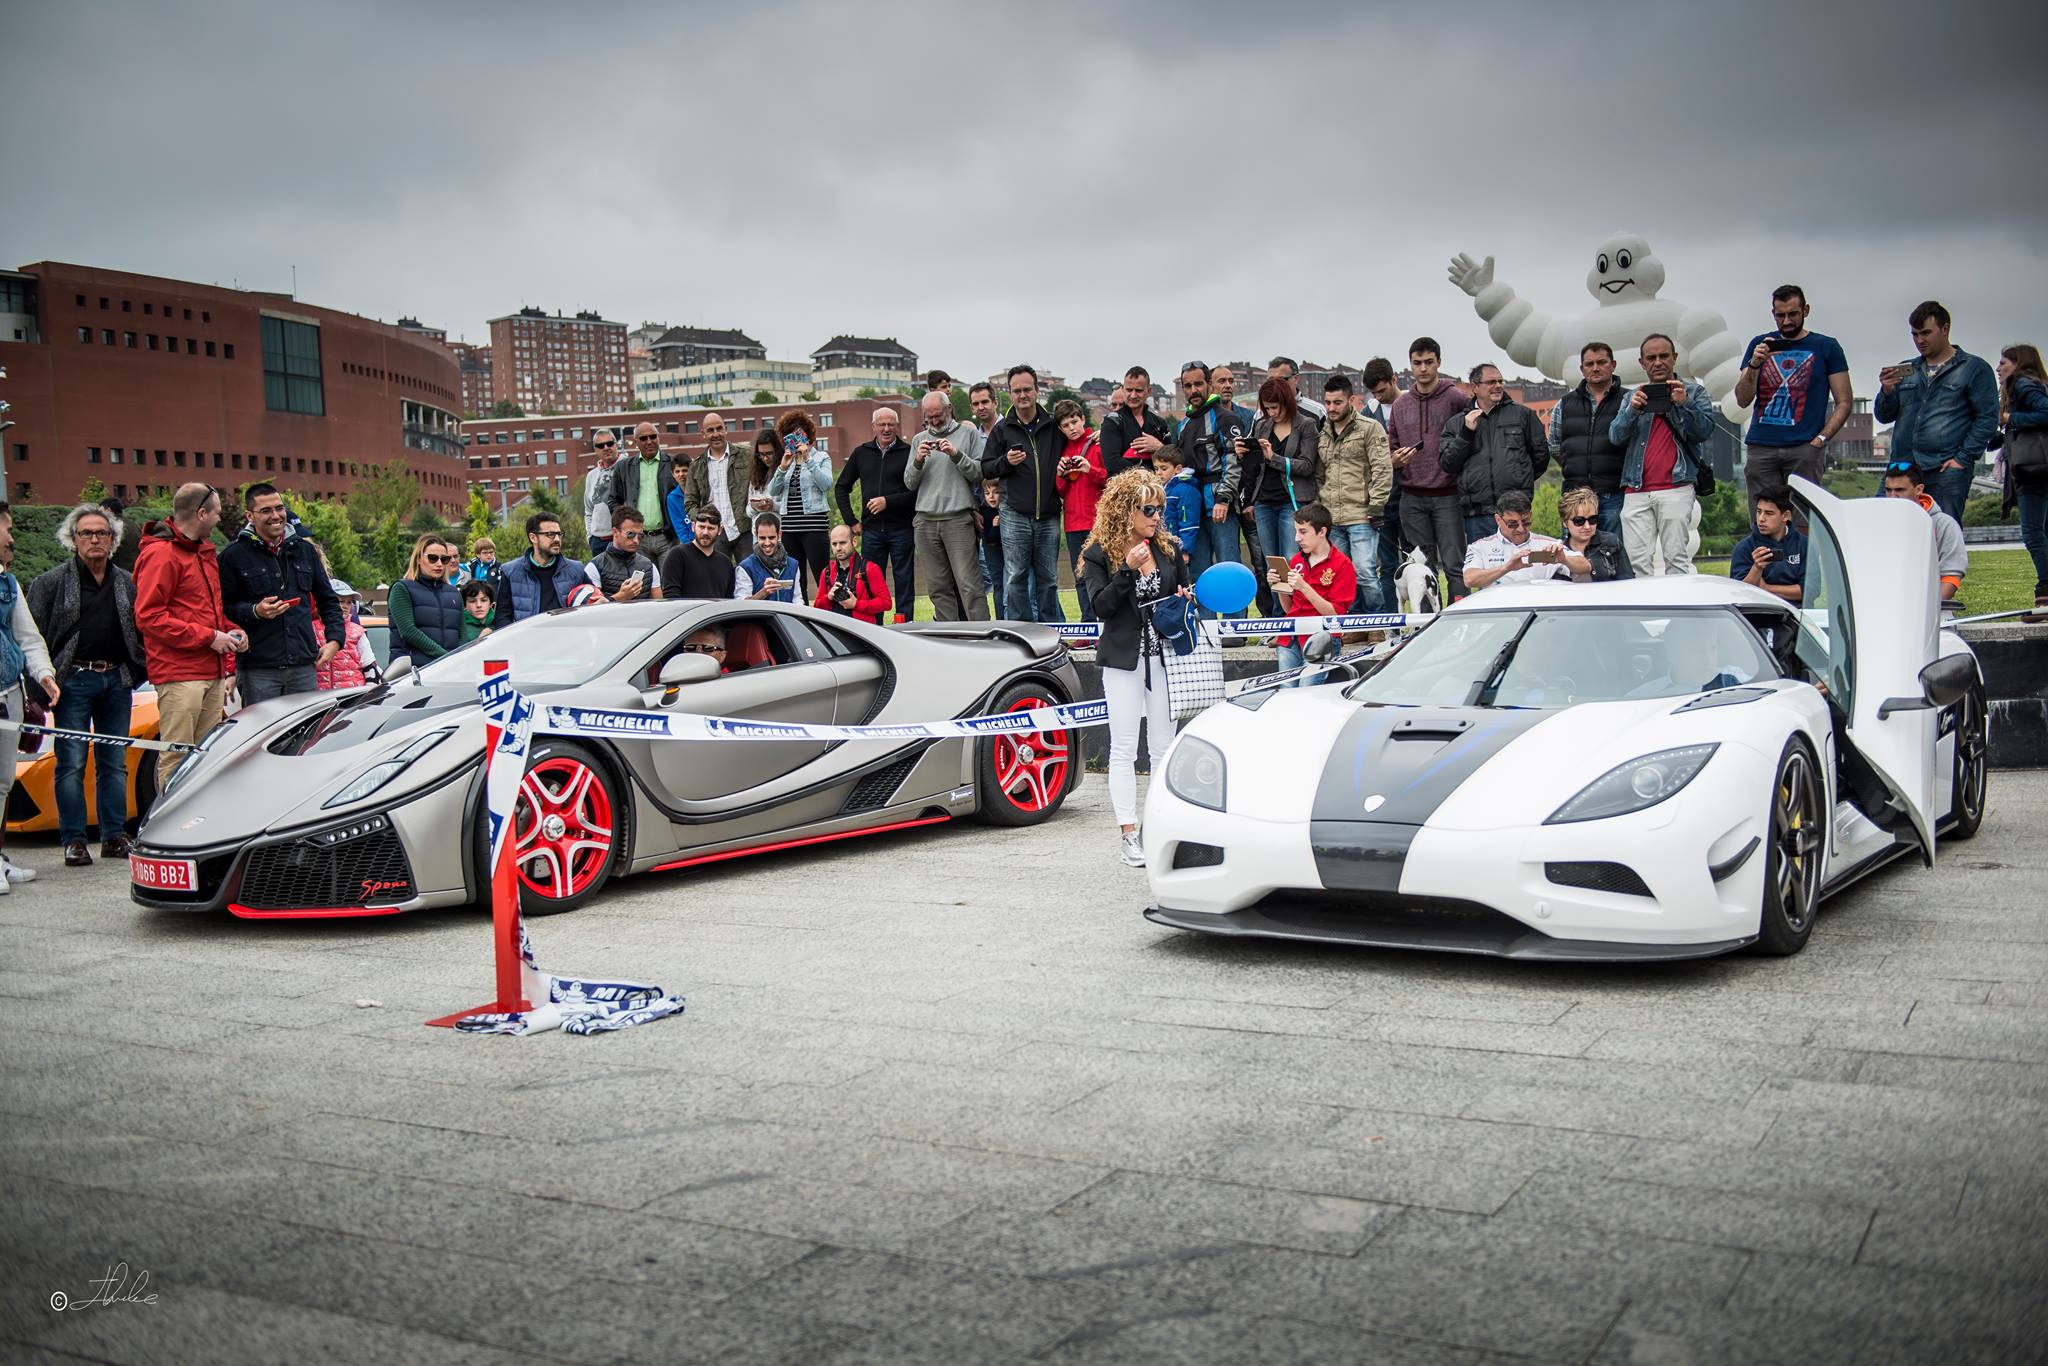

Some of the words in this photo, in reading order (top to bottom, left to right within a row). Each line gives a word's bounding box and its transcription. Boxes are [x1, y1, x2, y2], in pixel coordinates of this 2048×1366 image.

[1236, 621, 1292, 631] MICHELIN
[1342, 614, 1403, 626] MICHELIN
[1074, 704, 1107, 719] MICHE
[580, 712, 664, 731] MICHELIN
[975, 716, 1030, 731] MICHELIN
[733, 726, 807, 738] MICHELIN
[863, 727, 928, 737] MICHELIN
[136, 861, 156, 883] 1066
[160, 864, 187, 885] BBZ
